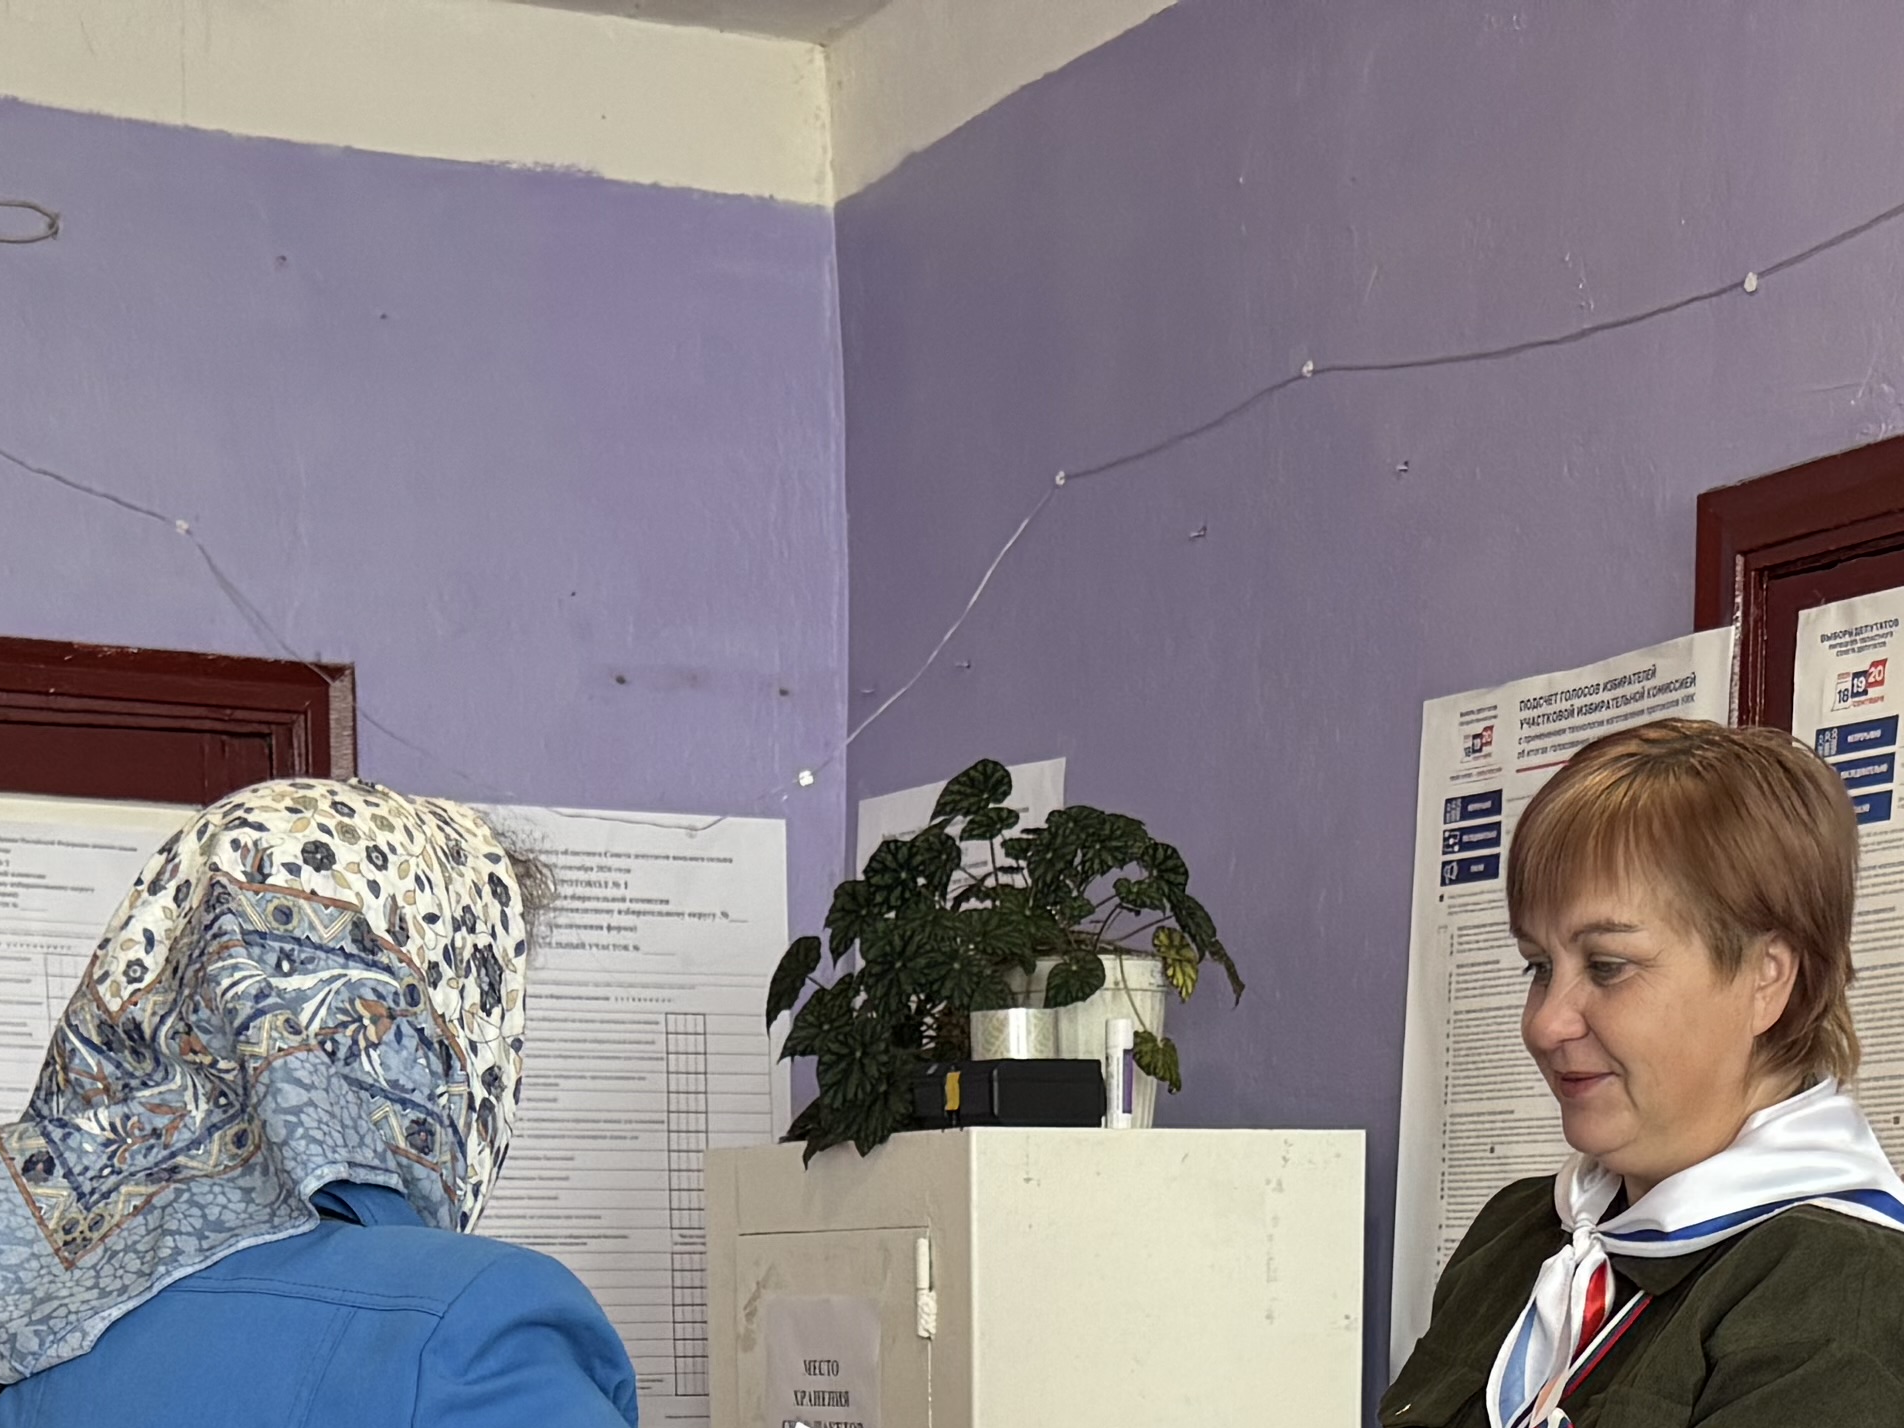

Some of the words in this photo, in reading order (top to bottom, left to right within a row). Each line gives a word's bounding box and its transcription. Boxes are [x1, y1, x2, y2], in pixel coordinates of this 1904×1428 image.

[1867, 665, 1884, 683] 20
[1852, 676, 1865, 694] 19
[1837, 688, 1849, 704] 18
[1519, 703, 1575, 730] УЧАСТКОВОЙ
[1576, 686, 1646, 718] ИЗБИРАТЕЛЬНОЙ
[803, 1359, 839, 1376] МЕСТО
